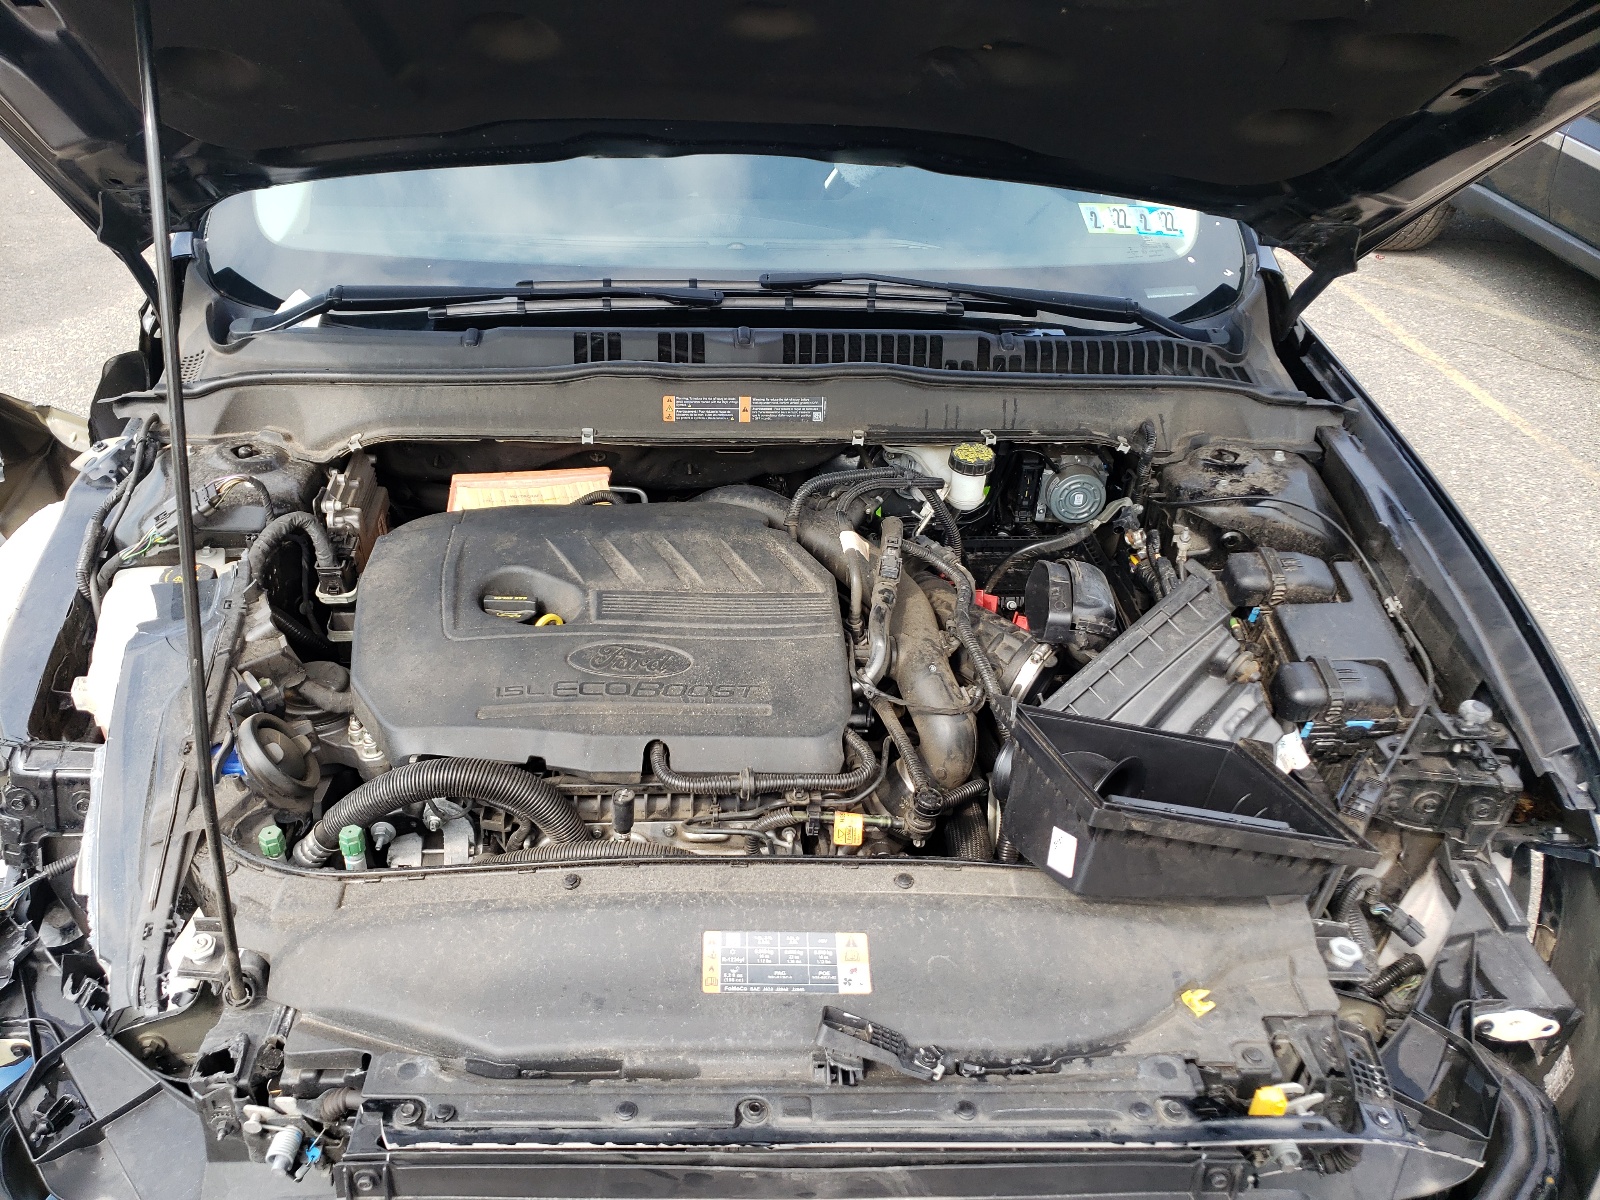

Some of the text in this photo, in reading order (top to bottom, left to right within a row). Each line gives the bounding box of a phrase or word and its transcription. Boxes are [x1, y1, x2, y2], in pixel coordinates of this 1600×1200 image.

[1112, 207, 1131, 229] 22
[1160, 210, 1179, 232] 22
[590, 643, 676, 674] Ford
[552, 679, 761, 700] ECOBOOST
